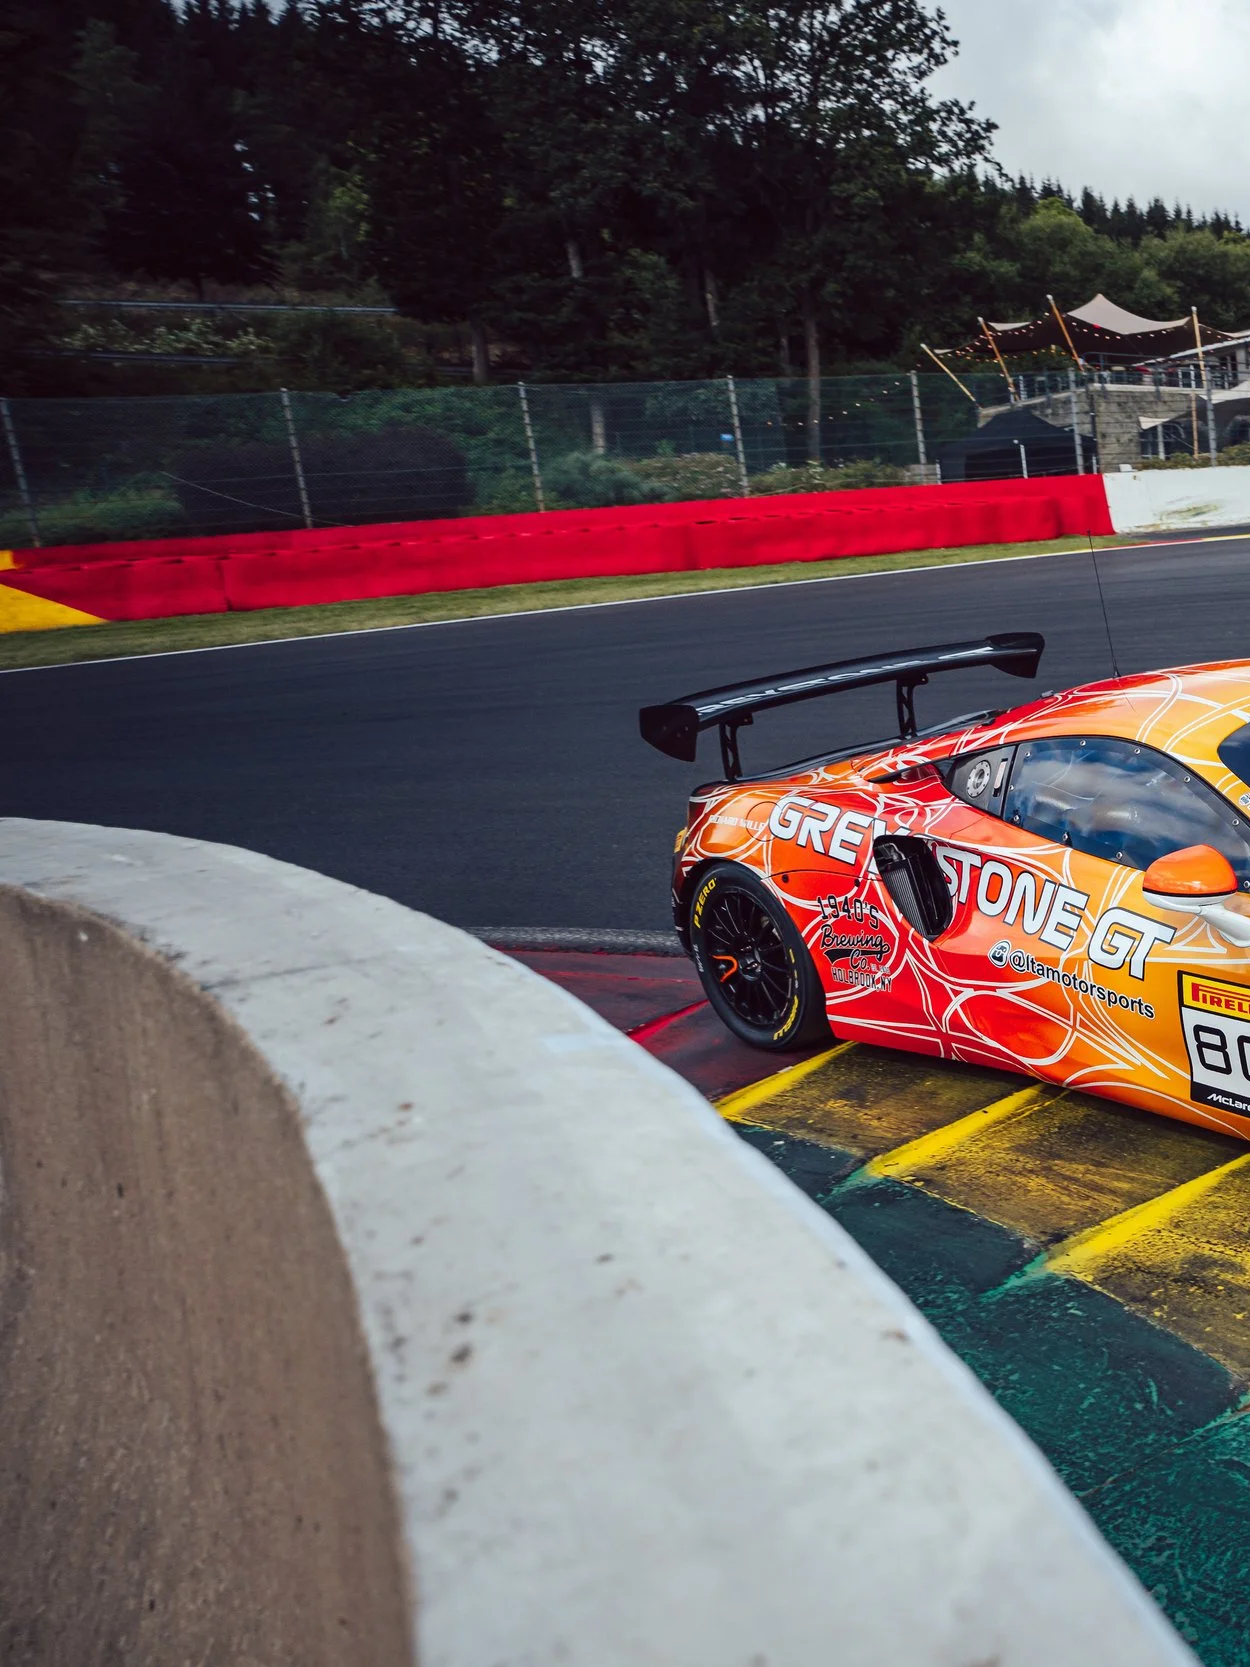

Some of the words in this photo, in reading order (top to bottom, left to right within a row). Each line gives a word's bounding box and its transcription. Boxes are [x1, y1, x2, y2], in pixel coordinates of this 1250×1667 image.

[820, 924, 891, 963] Brewing
[850, 948, 871, 970] Co.
[1088, 906, 1178, 982] GT
